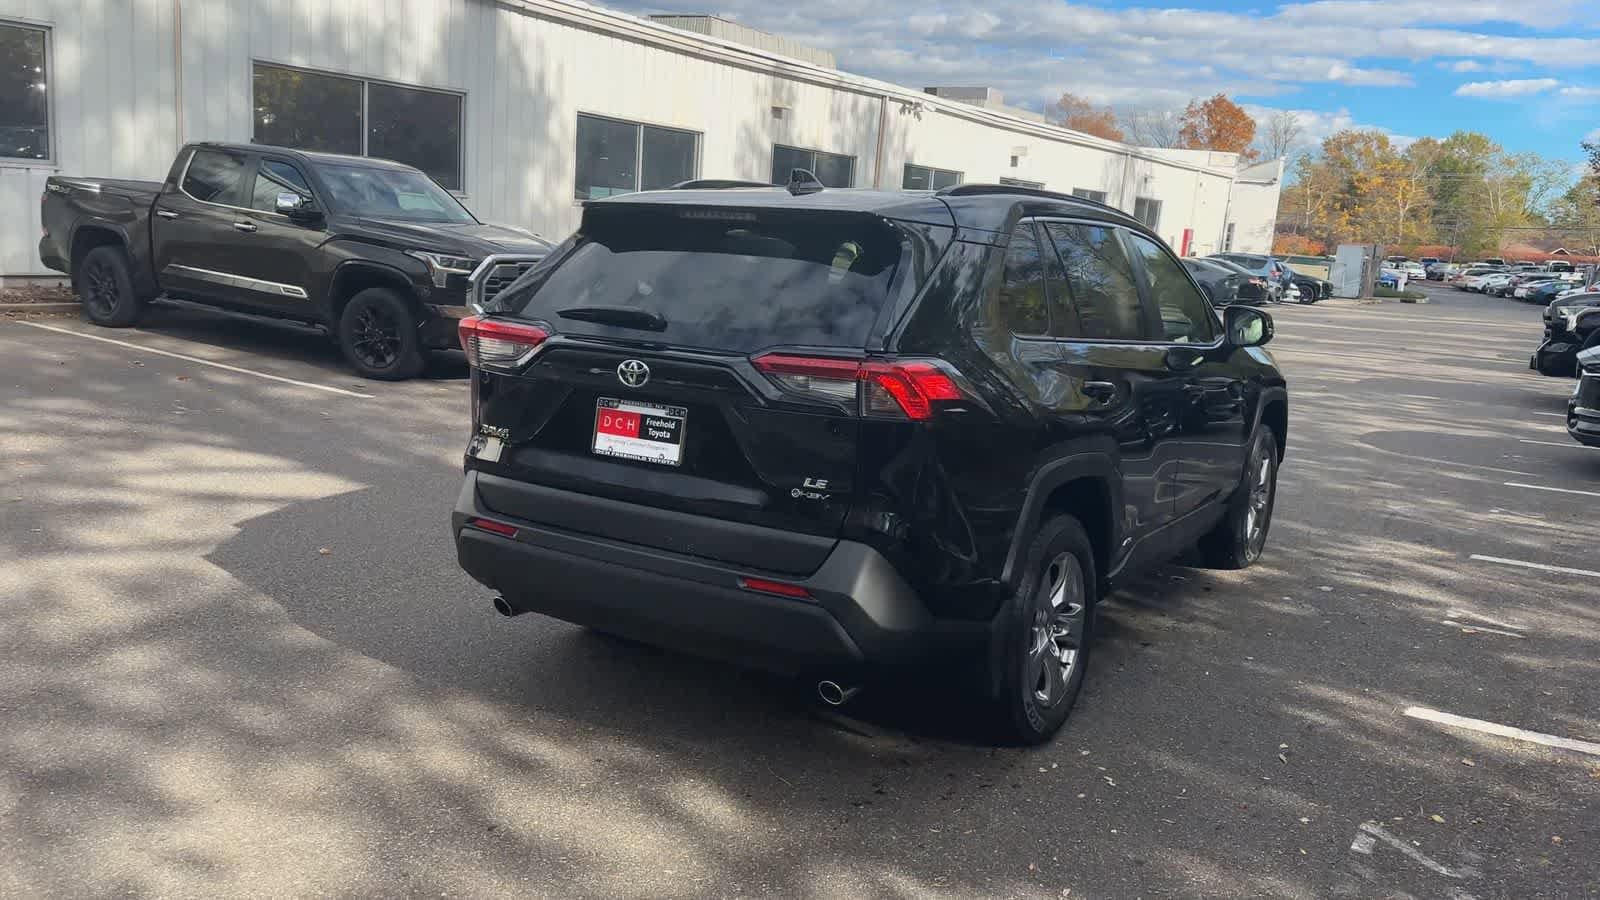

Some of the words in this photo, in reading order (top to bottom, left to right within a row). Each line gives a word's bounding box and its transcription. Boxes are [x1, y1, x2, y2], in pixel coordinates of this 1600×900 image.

[604, 415, 635, 431] DCH
[646, 418, 676, 429] Freehold
[648, 428, 671, 439] Toyota
[803, 477, 829, 489] LE
